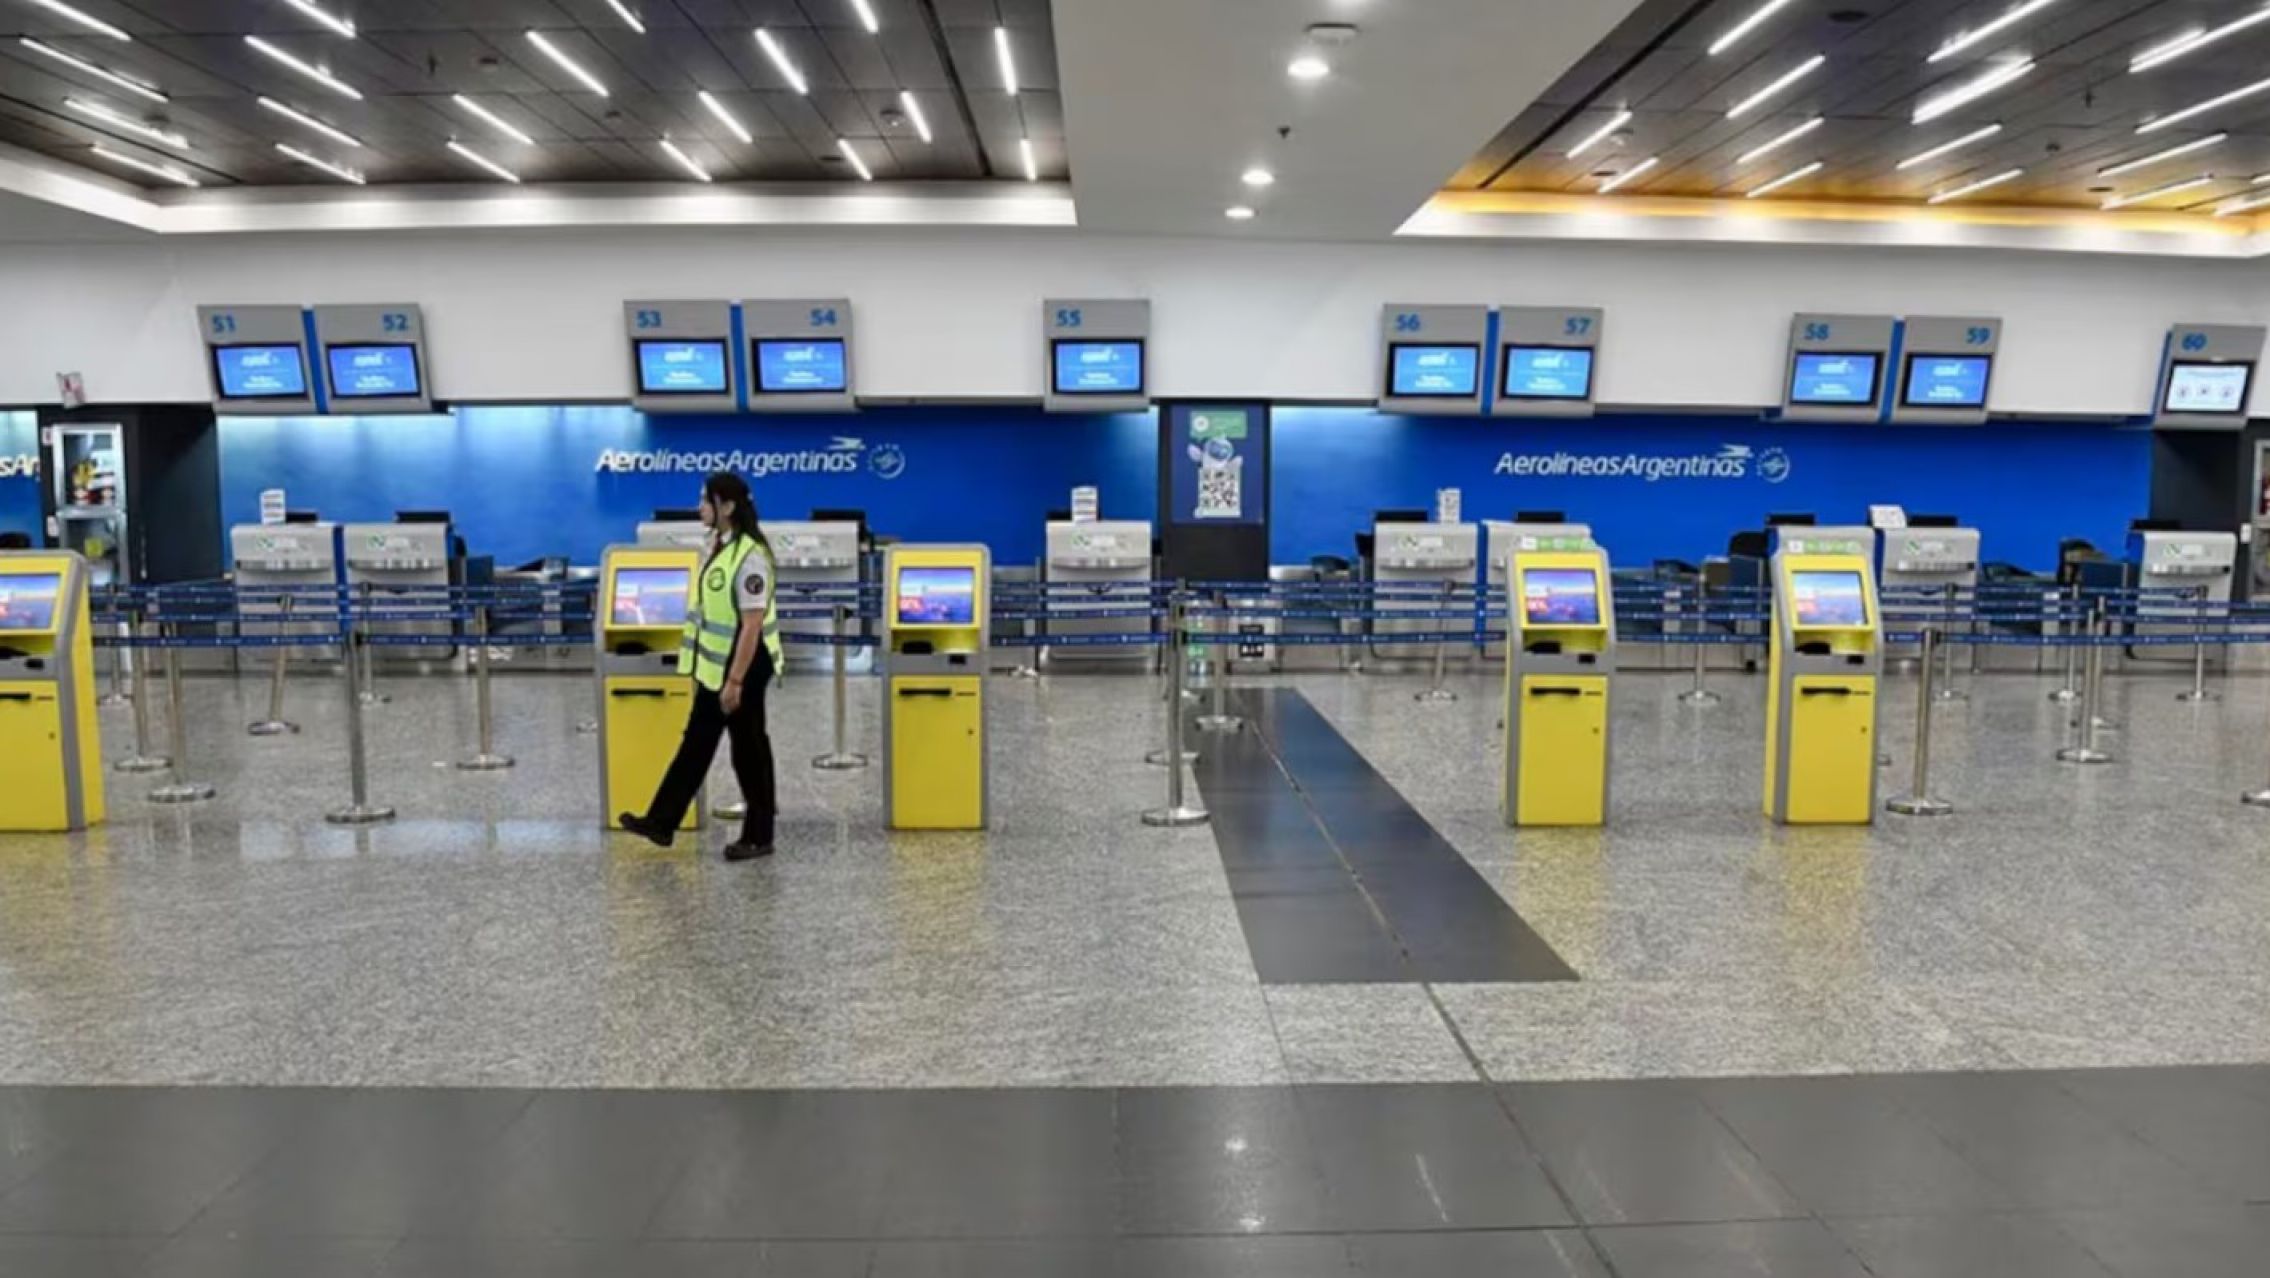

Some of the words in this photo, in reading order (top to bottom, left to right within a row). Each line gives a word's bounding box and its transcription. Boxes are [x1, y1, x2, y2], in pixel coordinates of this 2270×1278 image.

[211, 314, 236, 333] 51
[382, 313, 409, 332] 52
[636, 310, 662, 328] 53
[810, 308, 837, 326] 54
[1055, 309, 1081, 327] 55
[1395, 314, 1421, 332] 56
[1564, 317, 1591, 335] 57
[1804, 323, 1830, 341] 58
[1966, 327, 1991, 345] 59
[2181, 332, 2208, 351] 60
